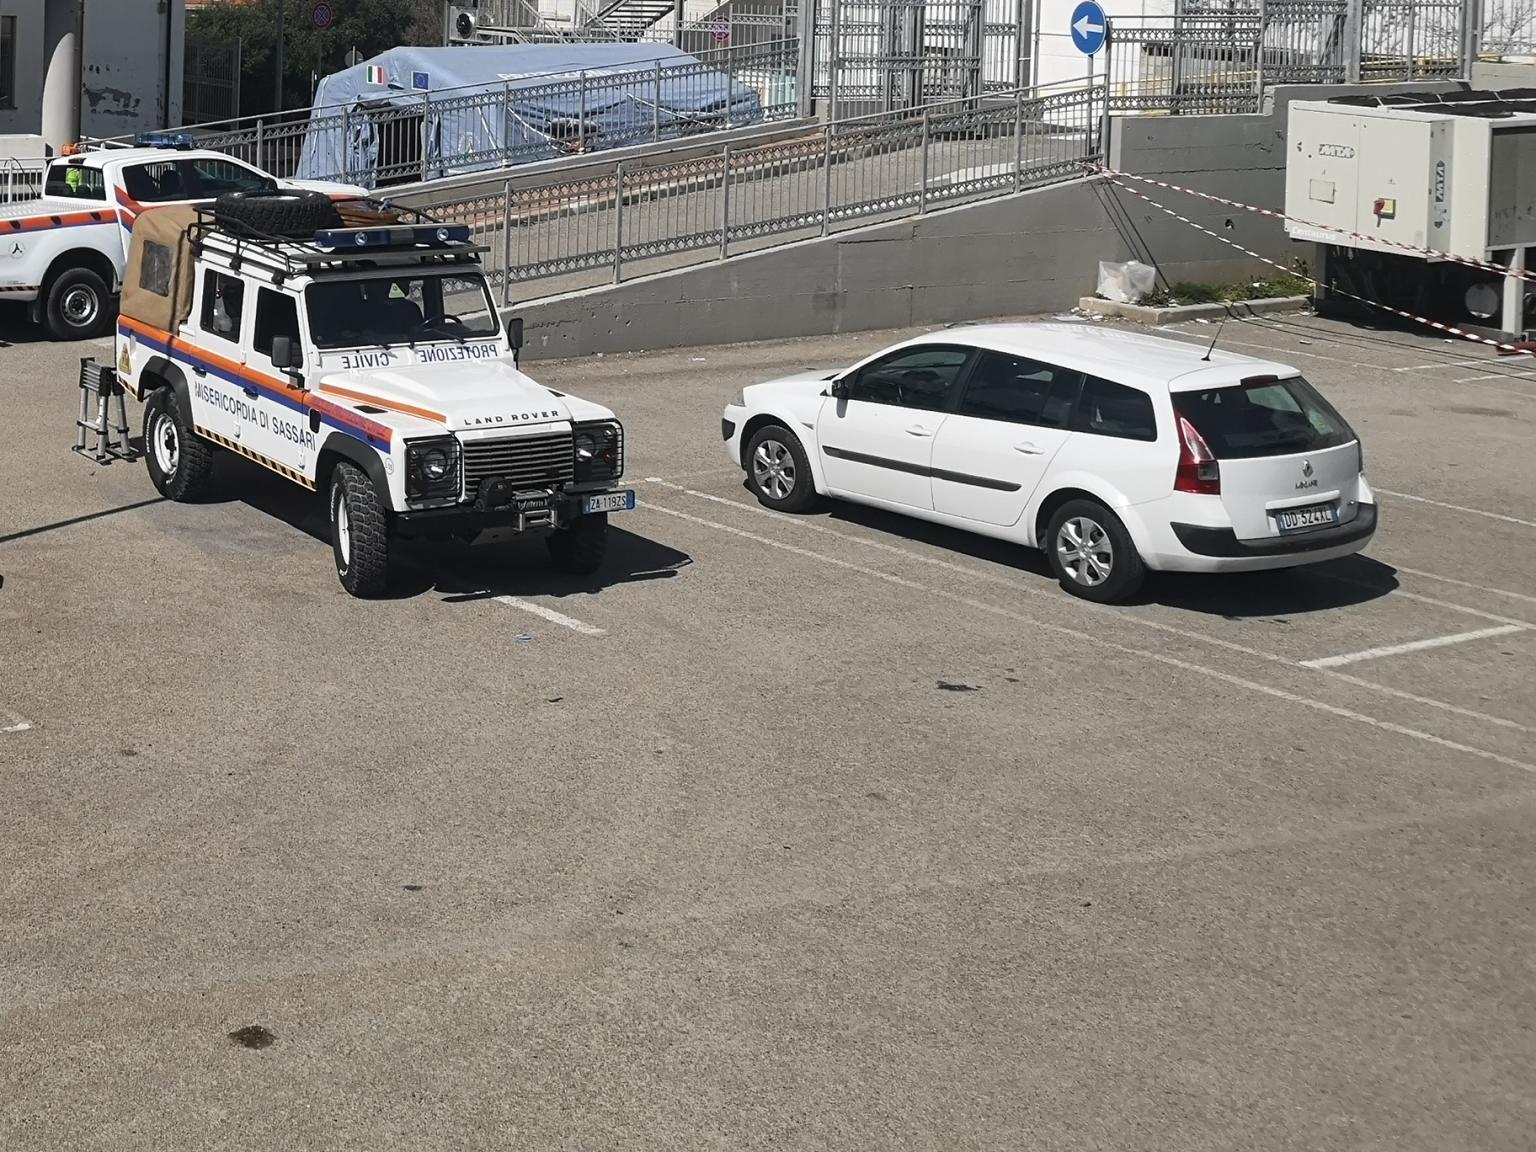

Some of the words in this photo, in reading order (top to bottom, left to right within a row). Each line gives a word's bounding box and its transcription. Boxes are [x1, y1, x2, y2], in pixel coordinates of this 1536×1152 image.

[195, 381, 258, 425] MISERICORDIA
[259, 410, 269, 430] DI
[272, 417, 316, 452] SASSARI
[464, 415, 503, 426] LAND
[511, 410, 559, 421] ROVER
